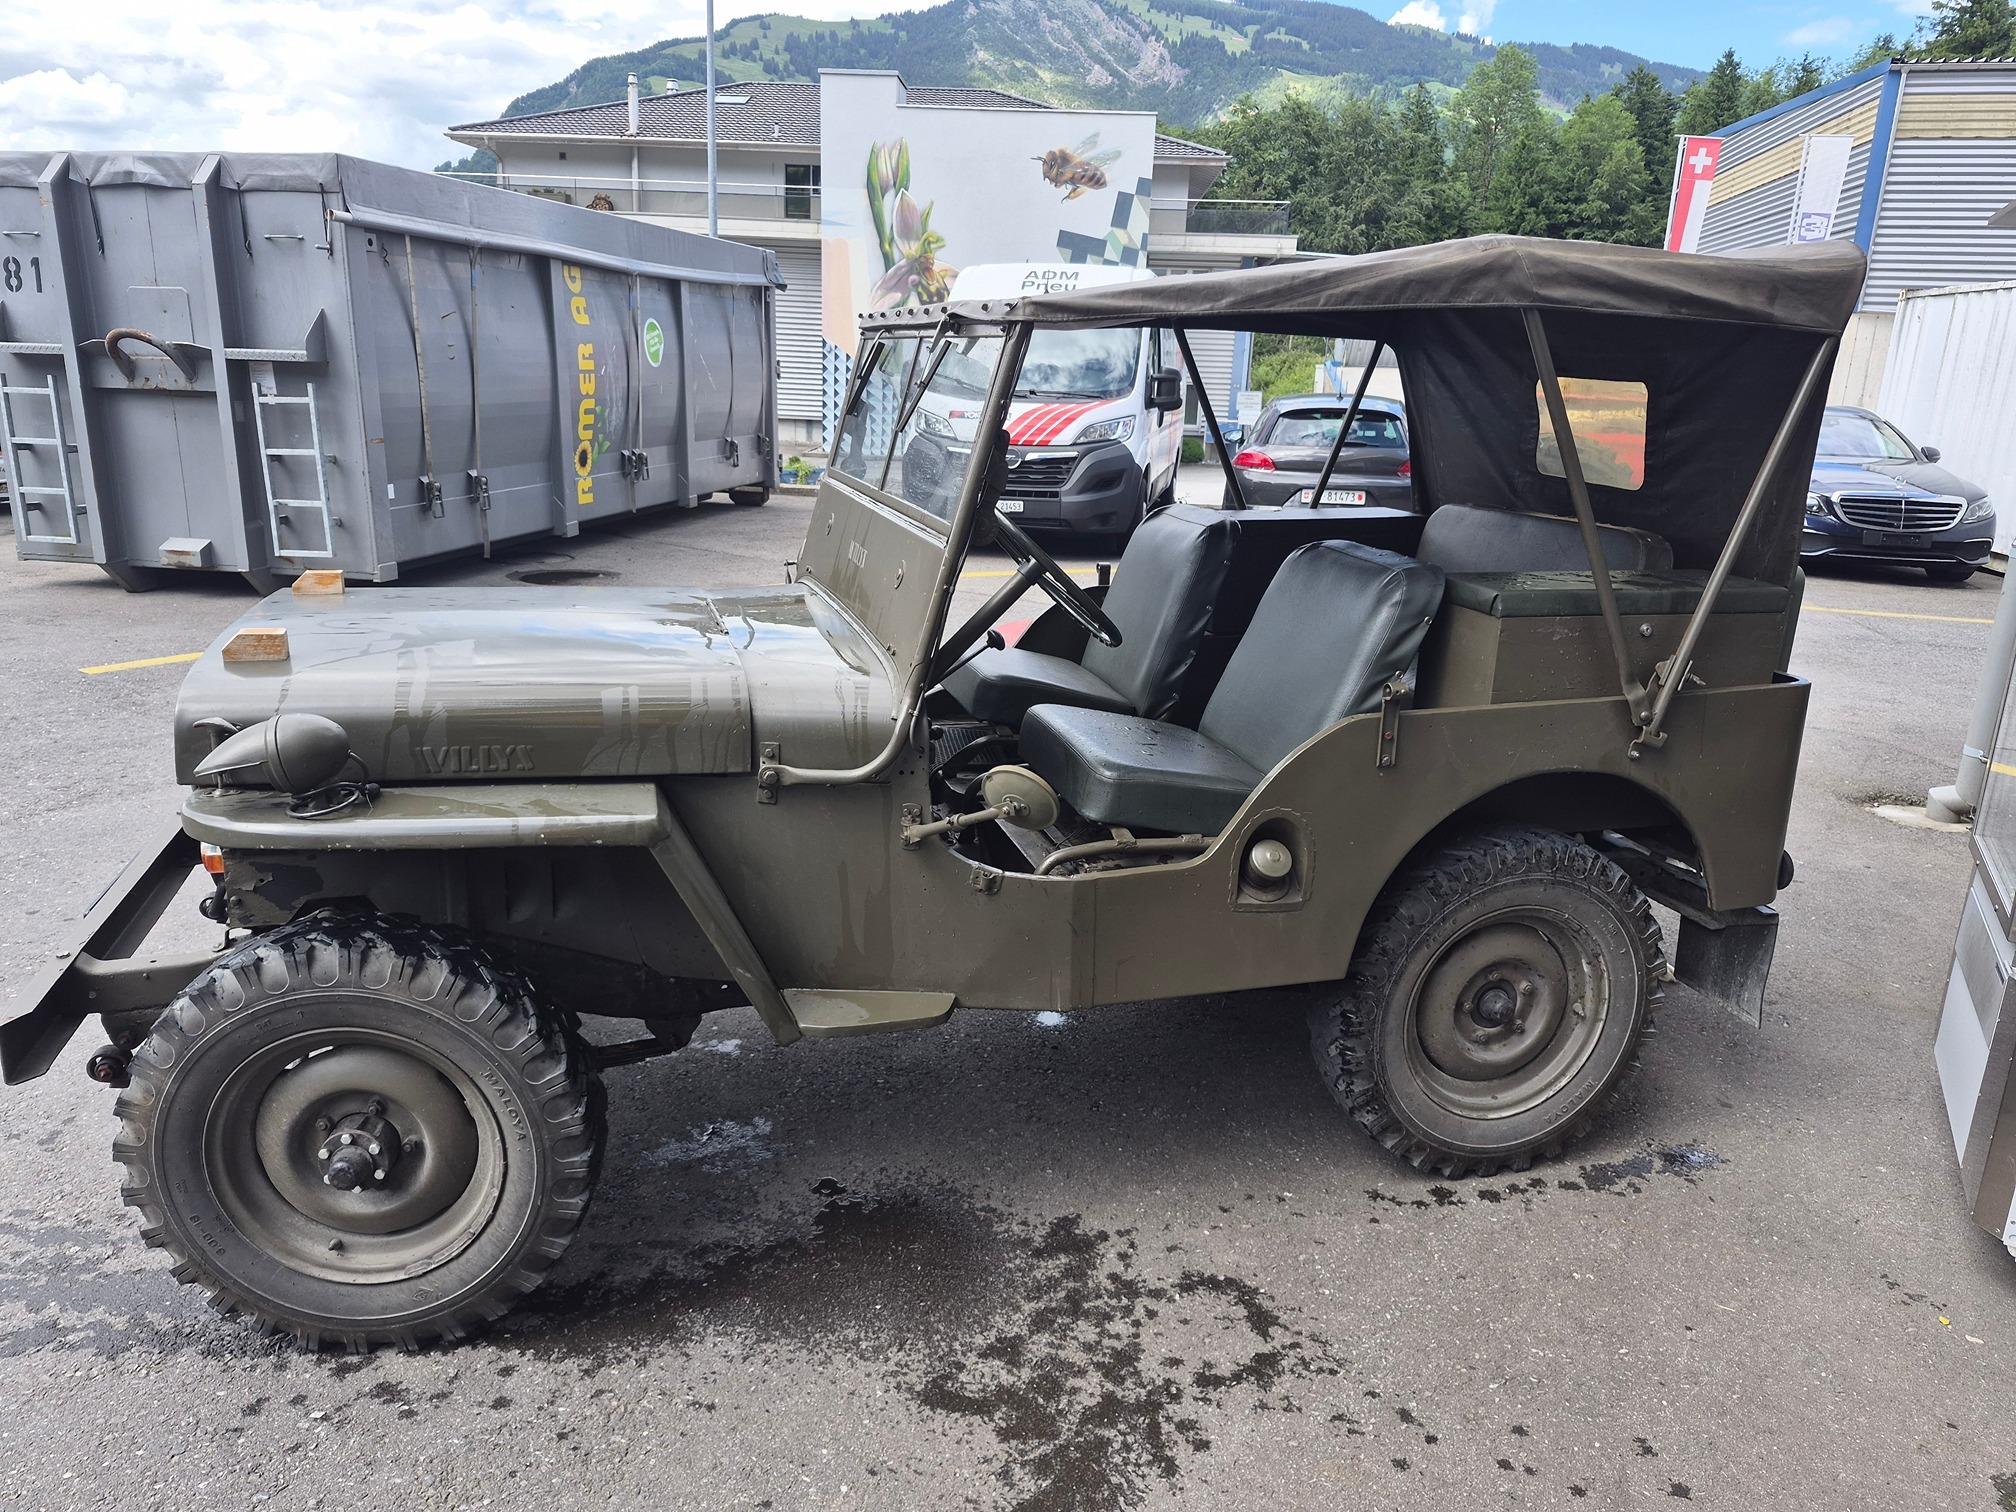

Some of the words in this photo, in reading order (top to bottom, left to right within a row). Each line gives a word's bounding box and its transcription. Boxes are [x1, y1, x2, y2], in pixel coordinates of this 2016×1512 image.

[3, 256, 43, 293] 81
[1021, 280, 1077, 292] Pneu
[1024, 270, 1080, 281] ADM
[563, 264, 590, 325] AG
[1000, 502, 1022, 511] 21453
[1327, 491, 1356, 503] 81473
[415, 744, 536, 774] WILLYS
[482, 1071, 527, 1141] MALOYA
[1543, 1079, 1595, 1125] MALOYA
